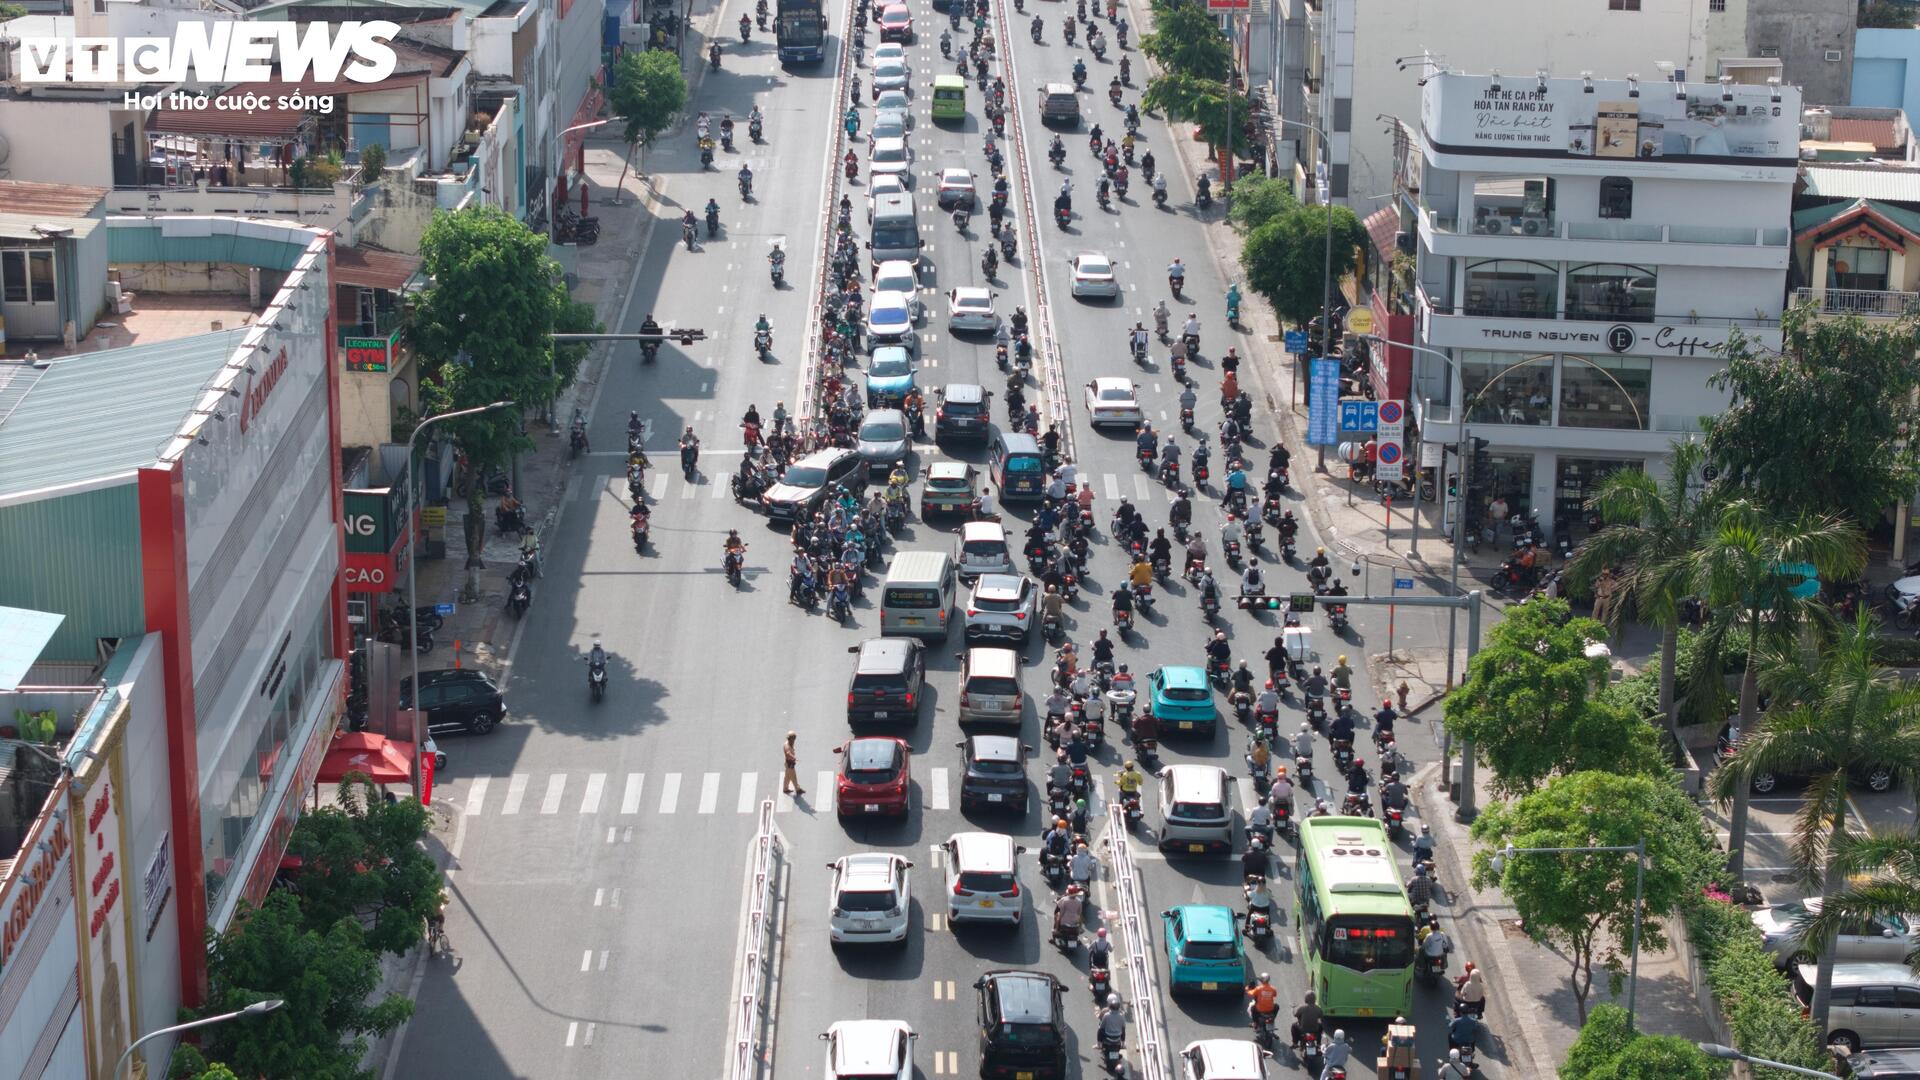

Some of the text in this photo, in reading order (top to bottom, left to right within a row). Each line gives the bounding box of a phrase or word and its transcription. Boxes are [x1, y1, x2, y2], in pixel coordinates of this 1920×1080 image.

[1494, 101, 1510, 111] TAN
[1512, 102, 1535, 112] RANG
[1538, 103, 1554, 112] XAY
[1481, 328, 1532, 339] TRUNG
[1538, 331, 1600, 342] NGUYEN
[348, 348, 385, 363] GYM
